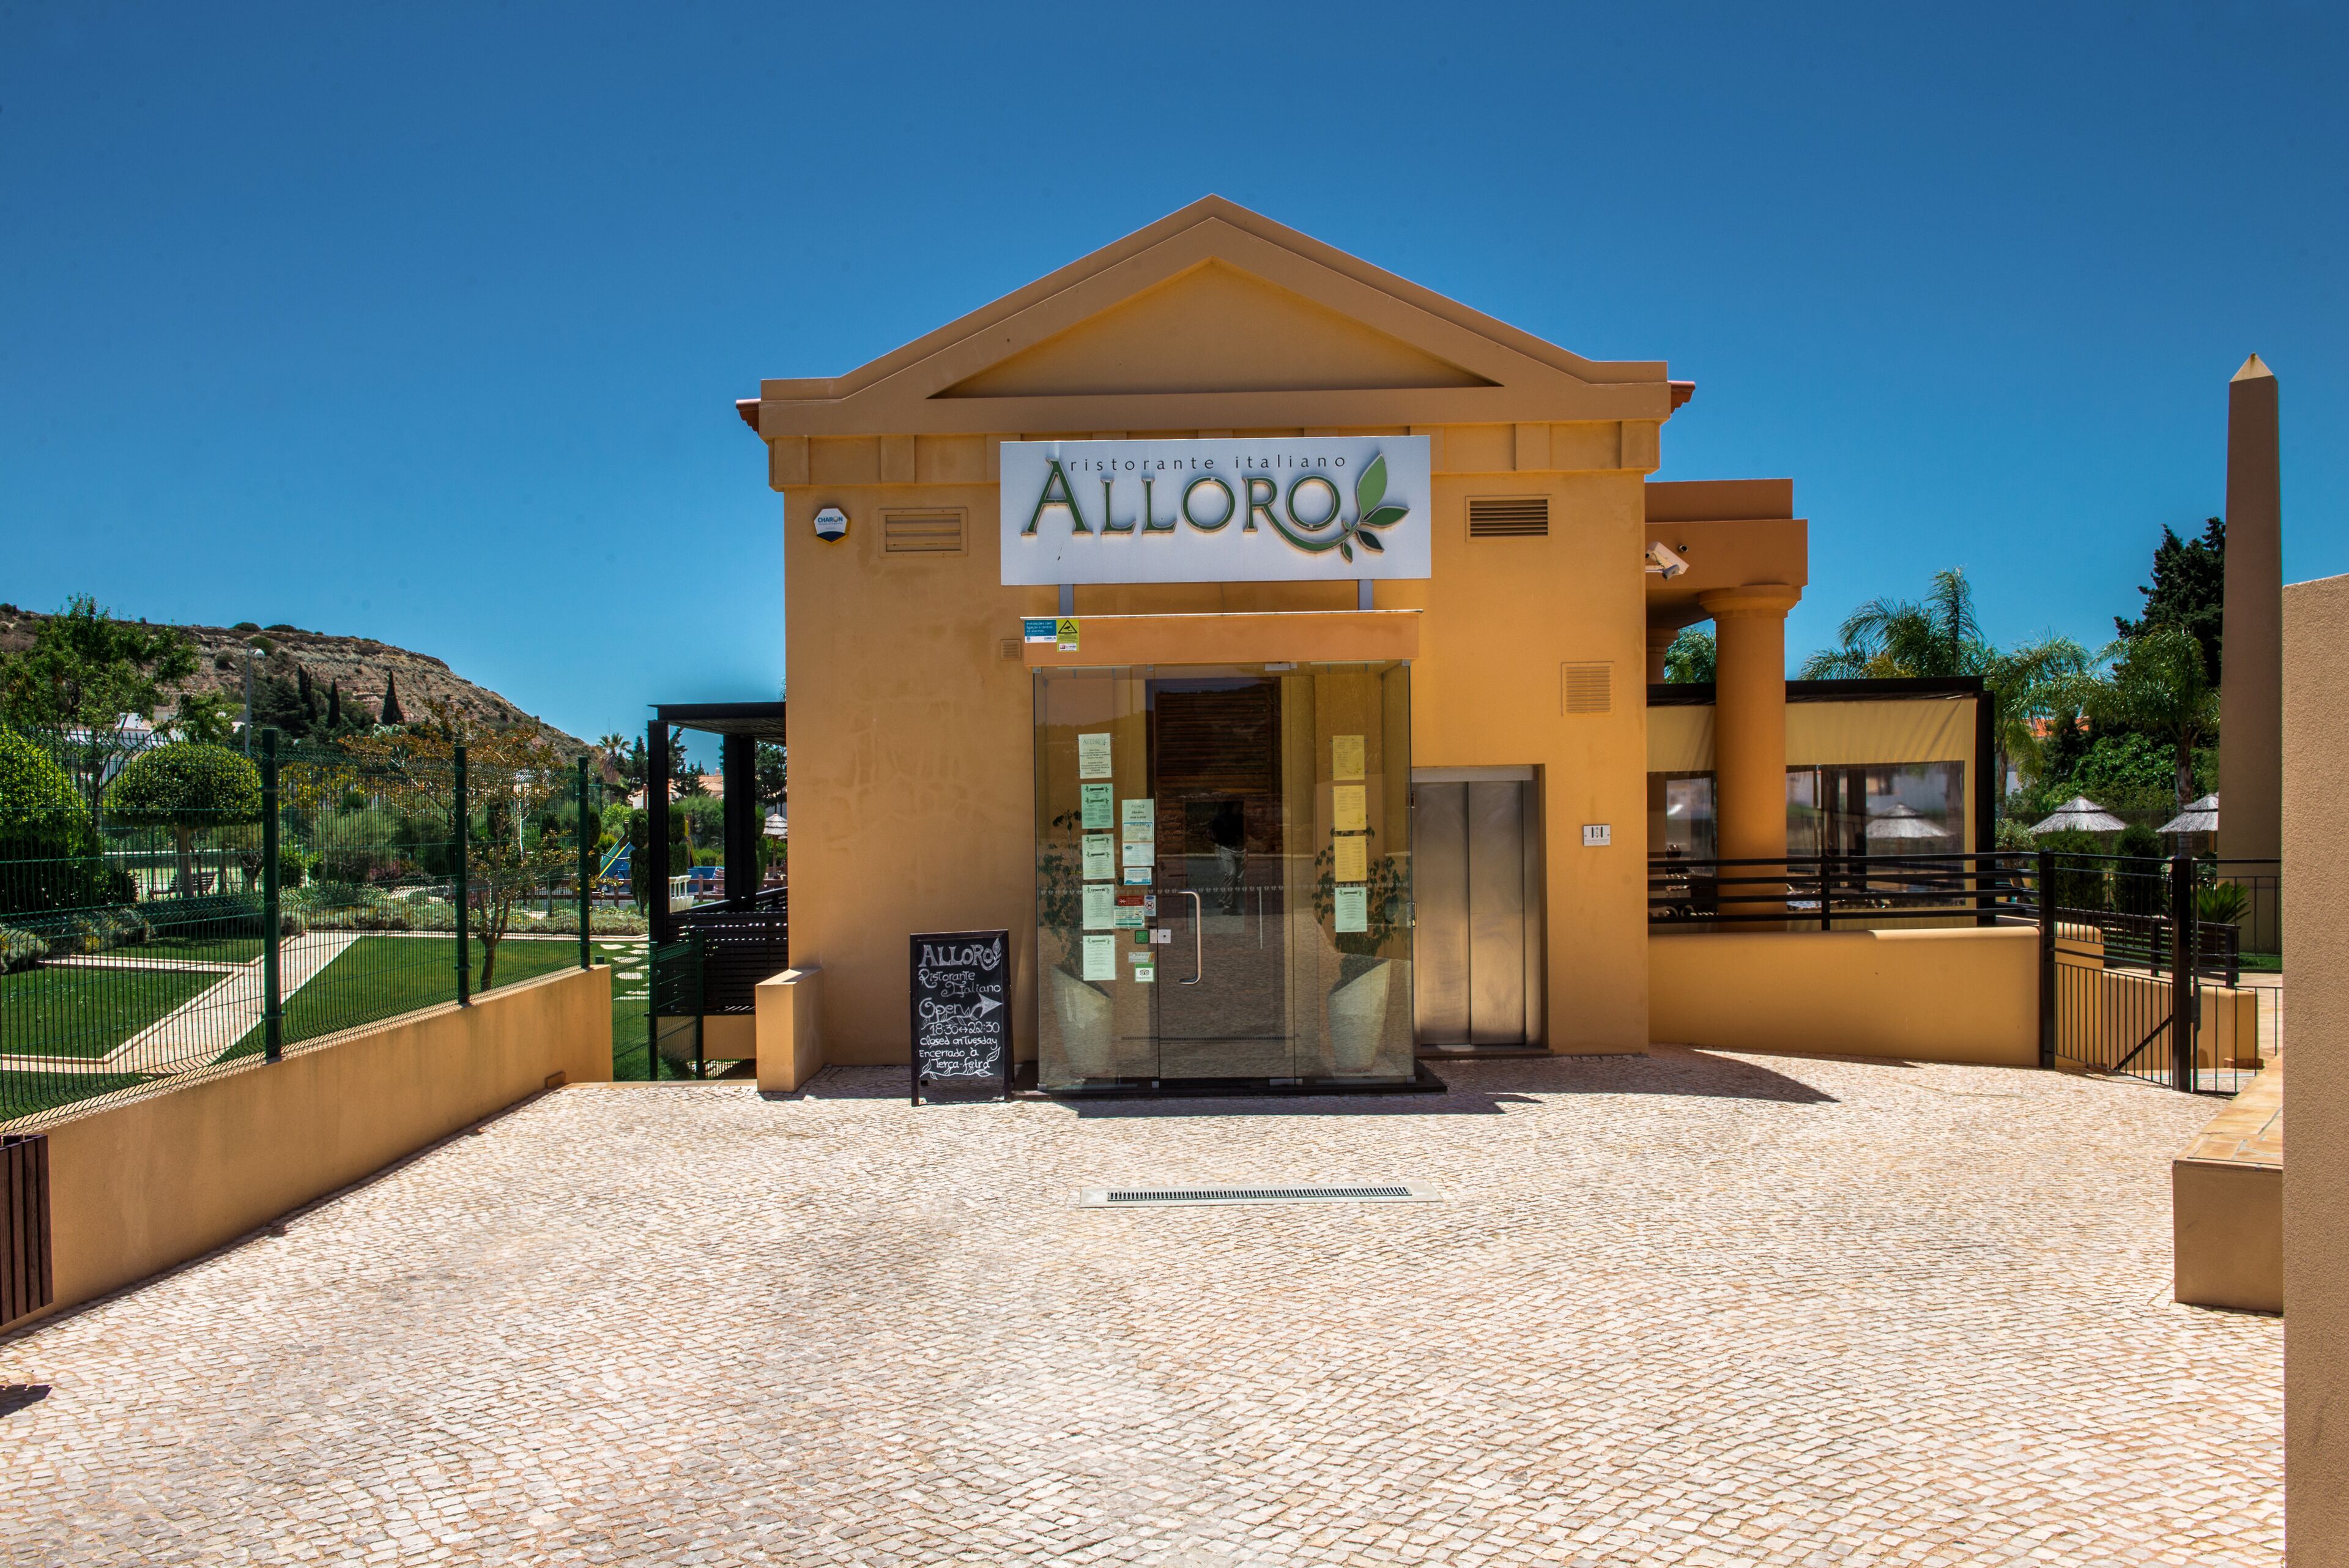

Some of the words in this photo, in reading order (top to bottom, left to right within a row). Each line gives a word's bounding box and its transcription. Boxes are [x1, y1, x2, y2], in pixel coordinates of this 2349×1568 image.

[1071, 455, 1214, 472] ristorante
[1234, 453, 1346, 469] italiano
[1020, 457, 1343, 554] ALLORO
[918, 944, 1000, 971] ALLORO
[918, 968, 976, 989] Ristorante
[941, 981, 1001, 998] Italiano
[919, 997, 967, 1023] Open
[930, 1023, 959, 1036] 18:30
[968, 1020, 1000, 1034] 22:30
[919, 1048, 965, 1058] Encerrado
[970, 1047, 979, 1057] à
